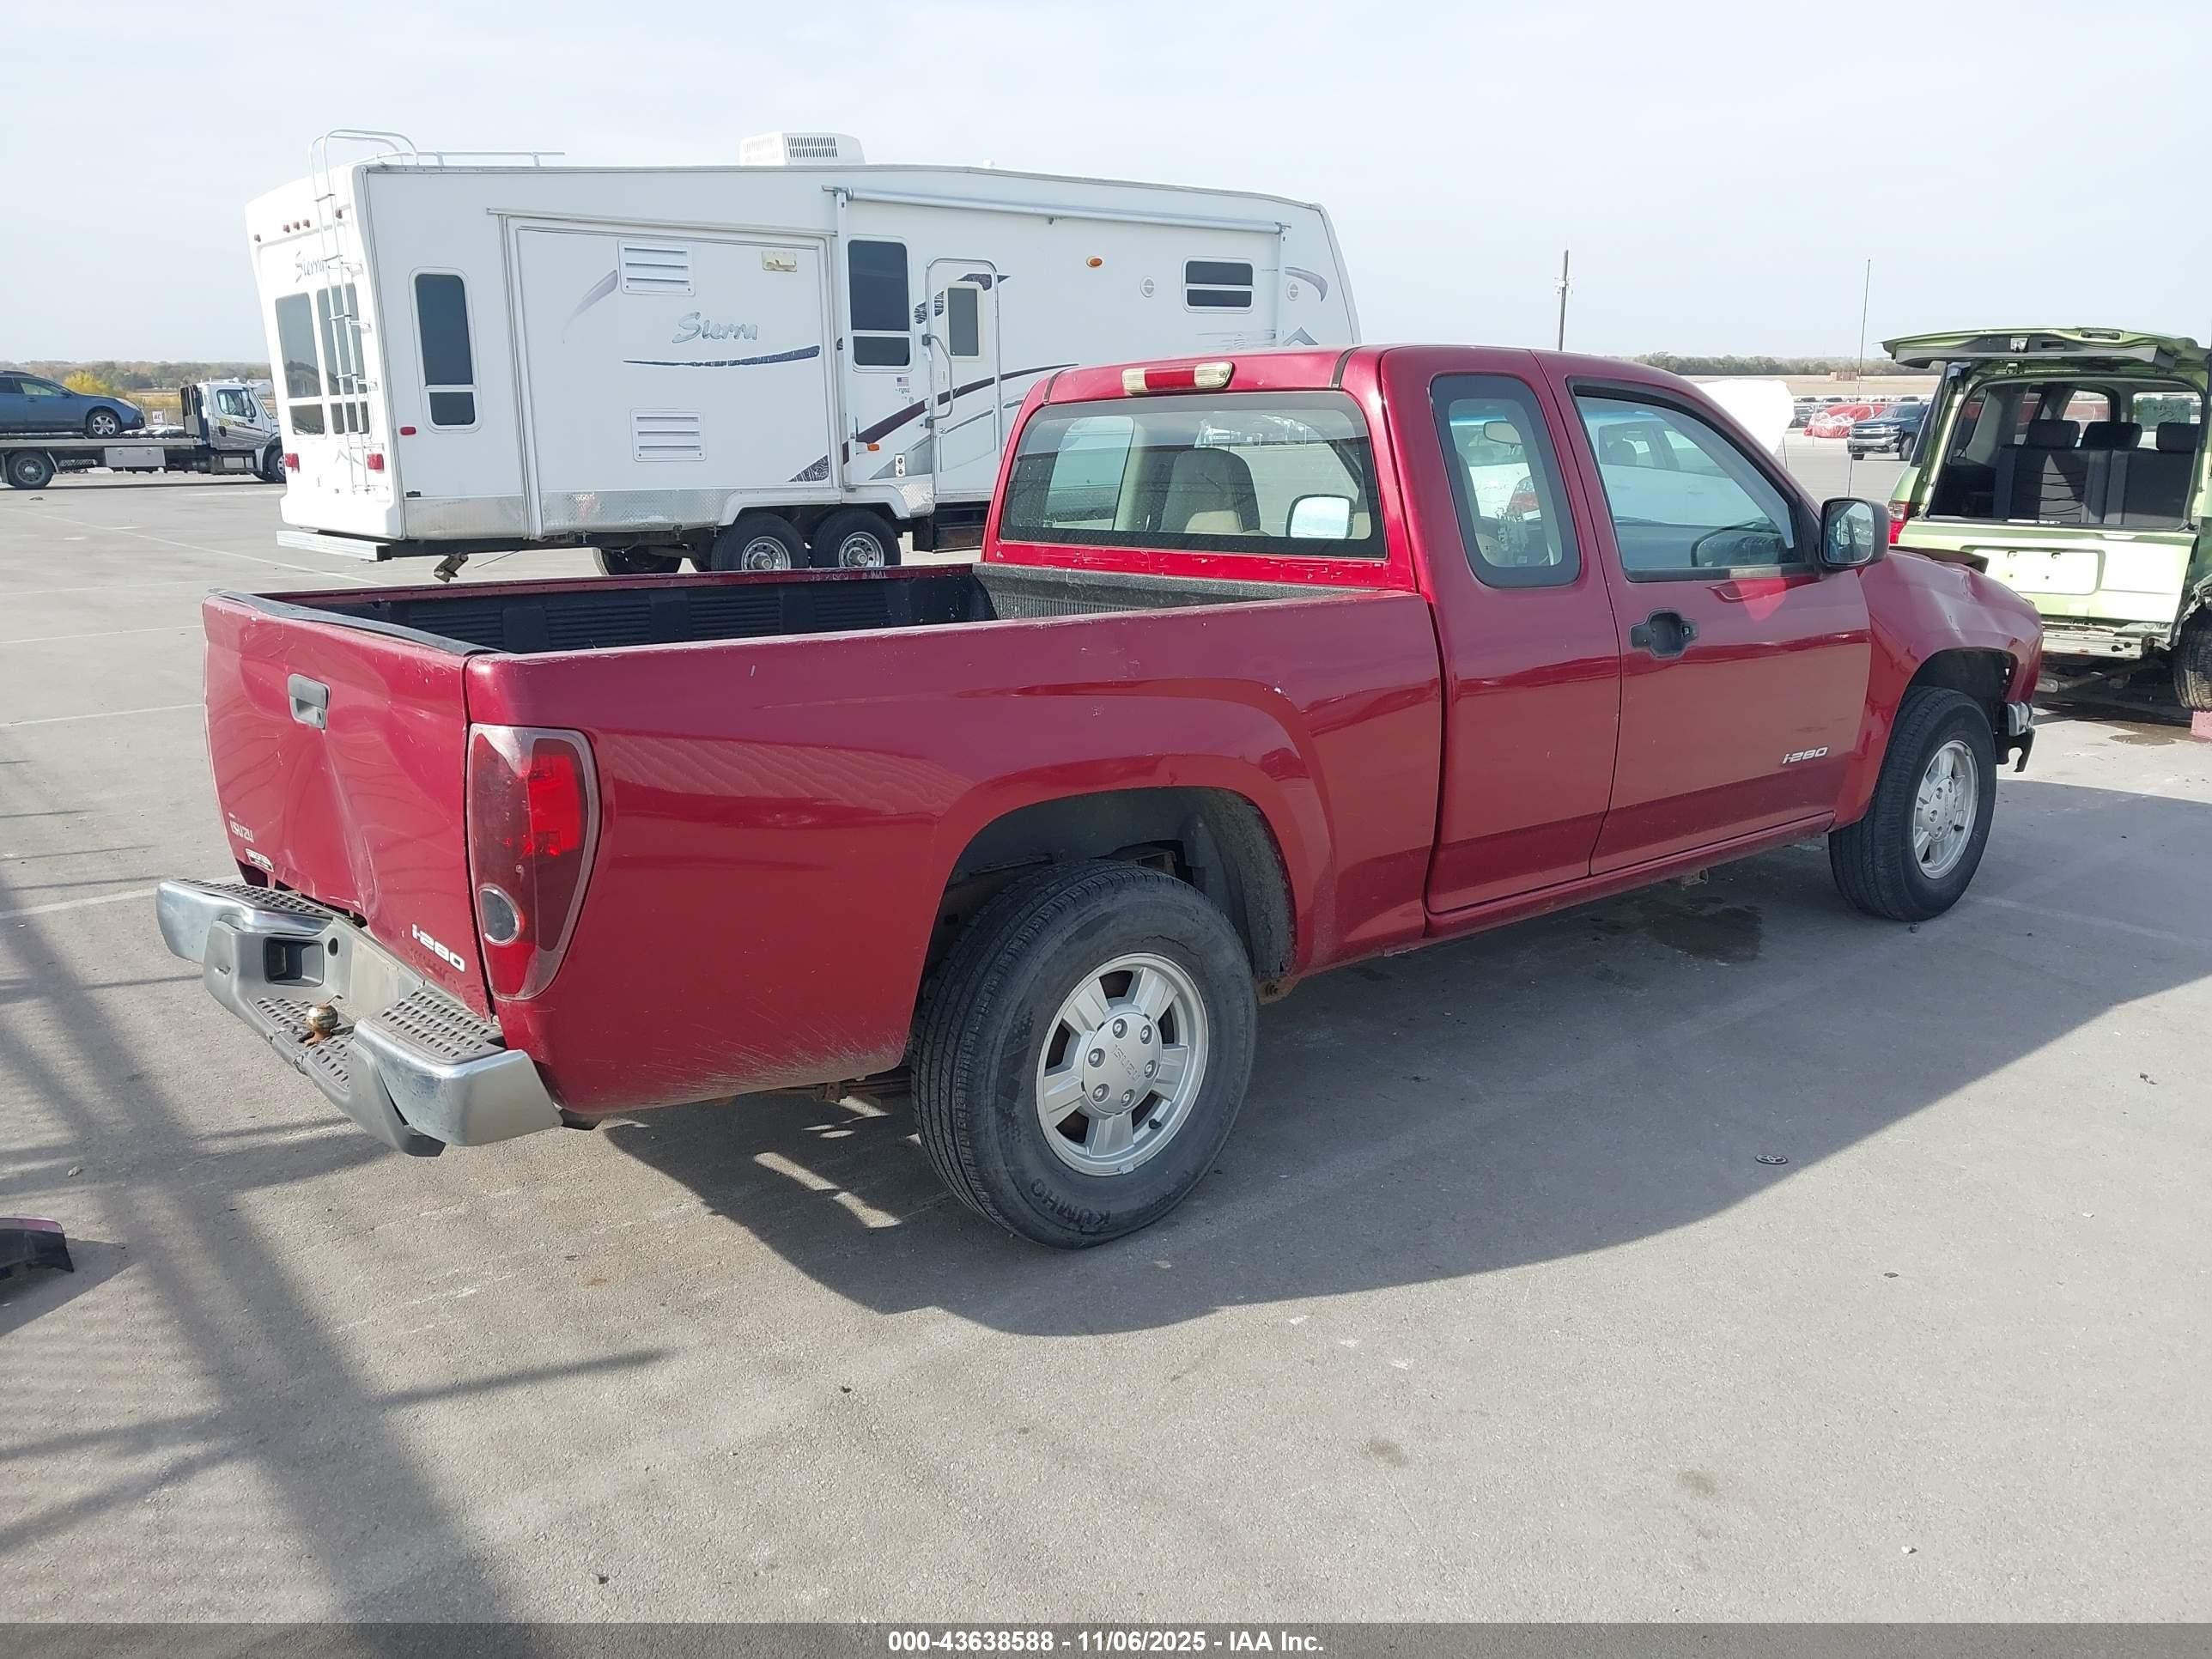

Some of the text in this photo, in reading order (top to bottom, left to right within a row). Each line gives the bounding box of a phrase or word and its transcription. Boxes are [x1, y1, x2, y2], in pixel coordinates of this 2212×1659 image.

[672, 311, 759, 343] Sierra
[1782, 746, 1828, 764] i-280
[229, 818, 254, 843] ISUZU
[412, 923, 465, 972] i-280
[1030, 1178, 1111, 1224] KUMHO
